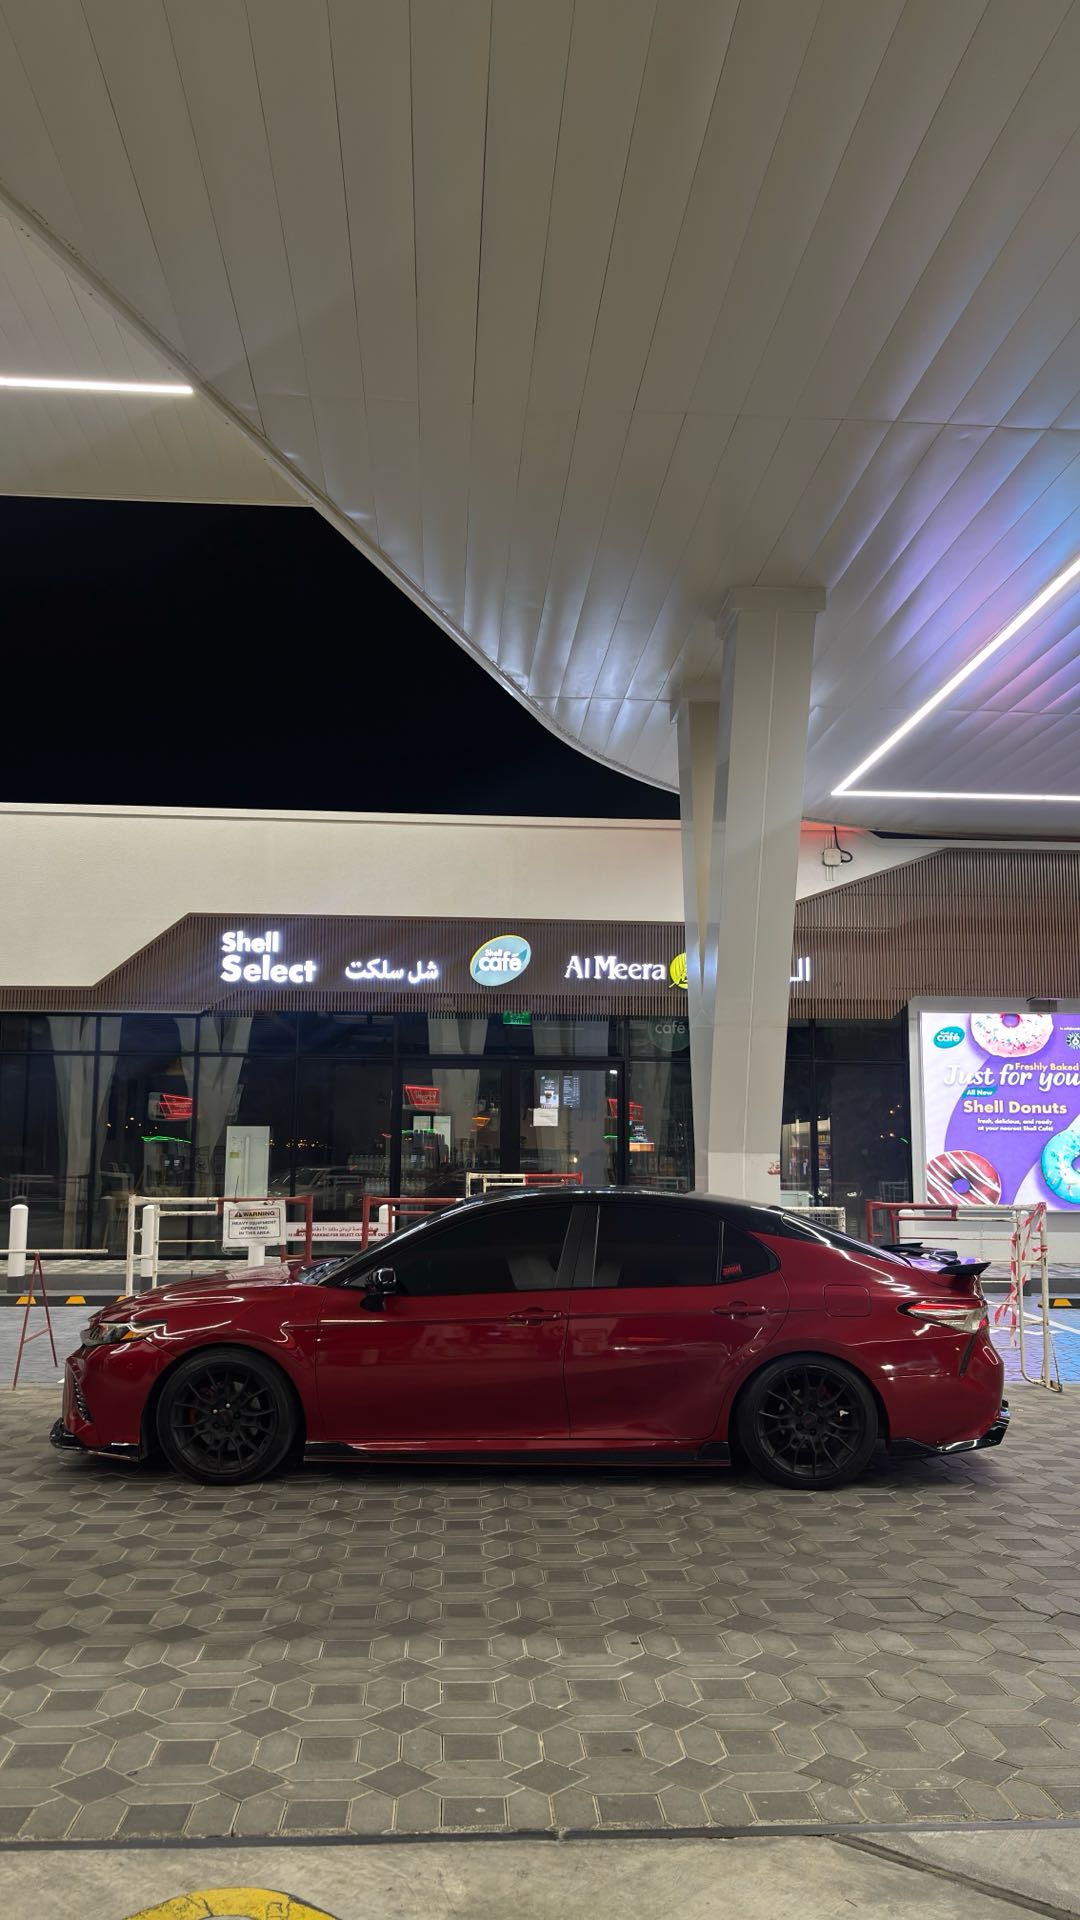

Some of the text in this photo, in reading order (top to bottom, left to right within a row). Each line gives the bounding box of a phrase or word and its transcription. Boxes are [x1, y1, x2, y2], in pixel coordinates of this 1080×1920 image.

[221, 930, 280, 953] Shell
[478, 950, 522, 972] café
[593, 955, 666, 980] Meera
[220, 954, 317, 984] Select
[345, 957, 440, 984] شل سلكت
[655, 1021, 686, 1035] café
[937, 1032, 960, 1042] café
[944, 1065, 995, 1086] Just
[999, 1063, 1032, 1086] for
[1015, 1062, 1080, 1073] Freshly Baked
[966, 1088, 976, 1096] All
[963, 1100, 1068, 1115] Shell Donuts
[1035, 1118, 1052, 1126] ready
[243, 1210, 276, 1218] WARNING
